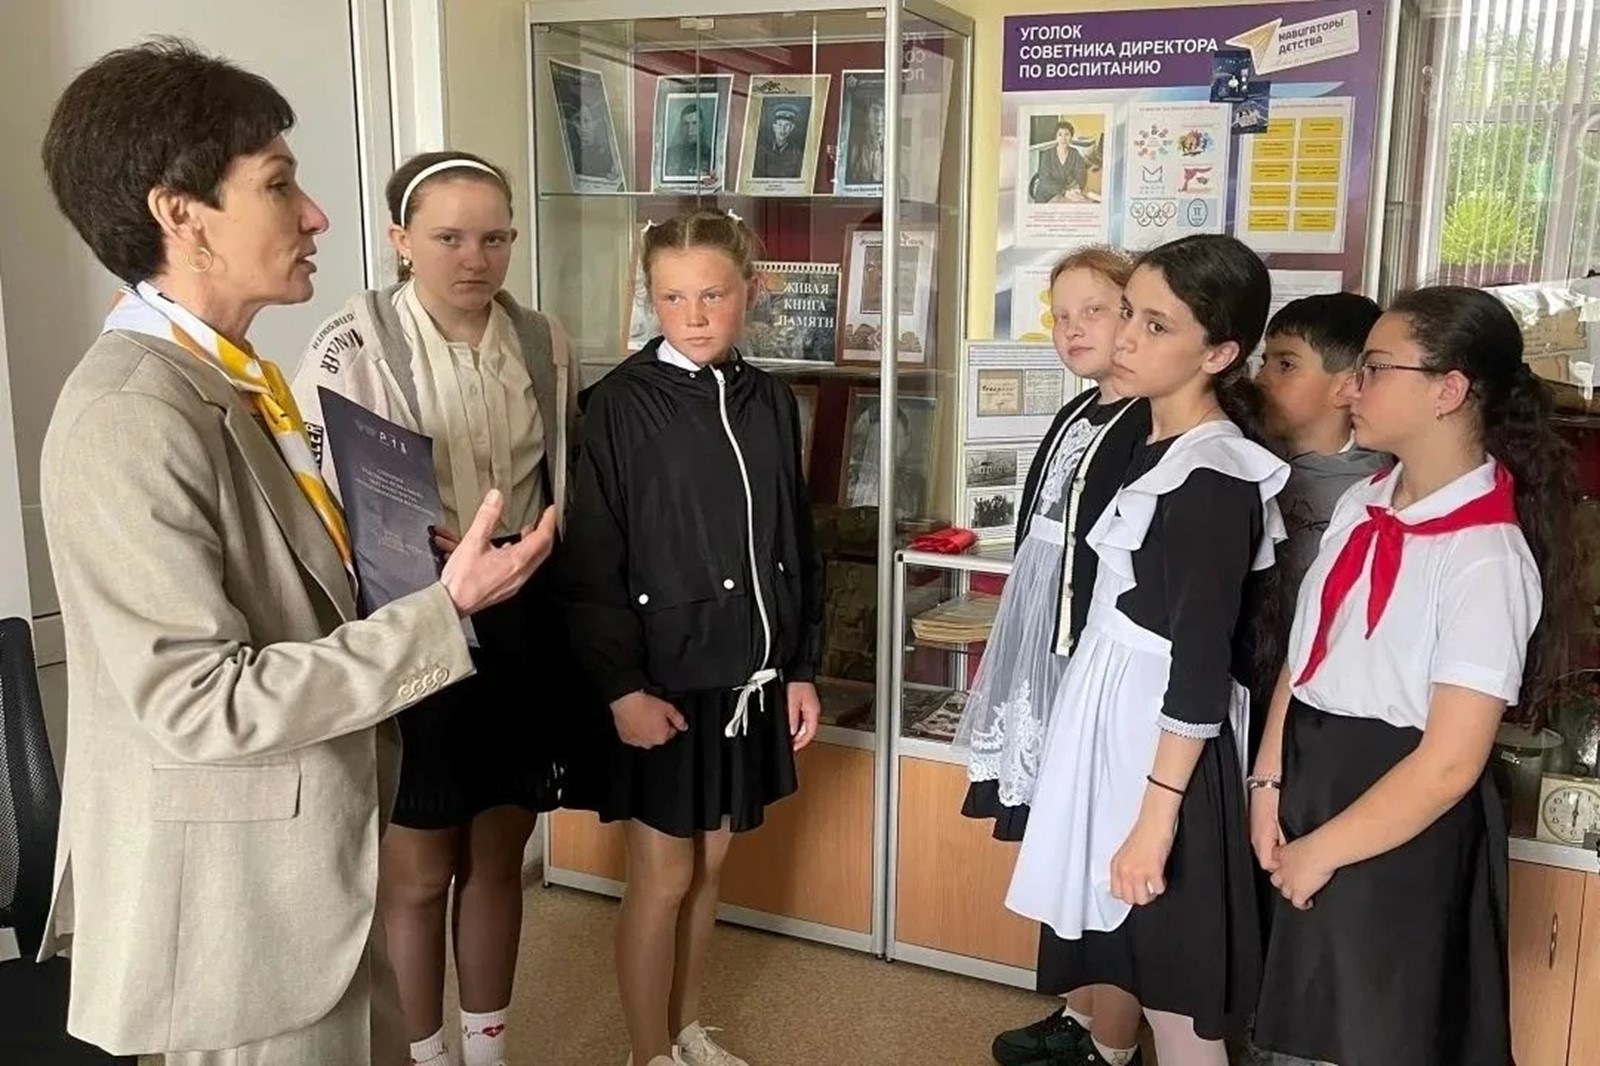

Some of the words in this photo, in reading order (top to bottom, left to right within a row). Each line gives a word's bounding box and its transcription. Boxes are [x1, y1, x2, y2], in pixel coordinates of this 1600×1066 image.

[1020, 25, 1082, 41] УГОЛОК
[1278, 18, 1344, 42] НАВИГАТОРЫ
[1020, 43, 1115, 59] СОВЕТНИКА
[1119, 38, 1219, 58] ДИРЕКТОРА
[1278, 35, 1323, 55] ДЕТСТВА
[1019, 64, 1041, 78] ПО
[1046, 60, 1161, 77] ВОСПИТАНИЮ
[783, 281, 829, 295] ЖИВАЯ
[784, 298, 826, 312] КНИГА
[779, 314, 834, 328] ПАМЯТИ
